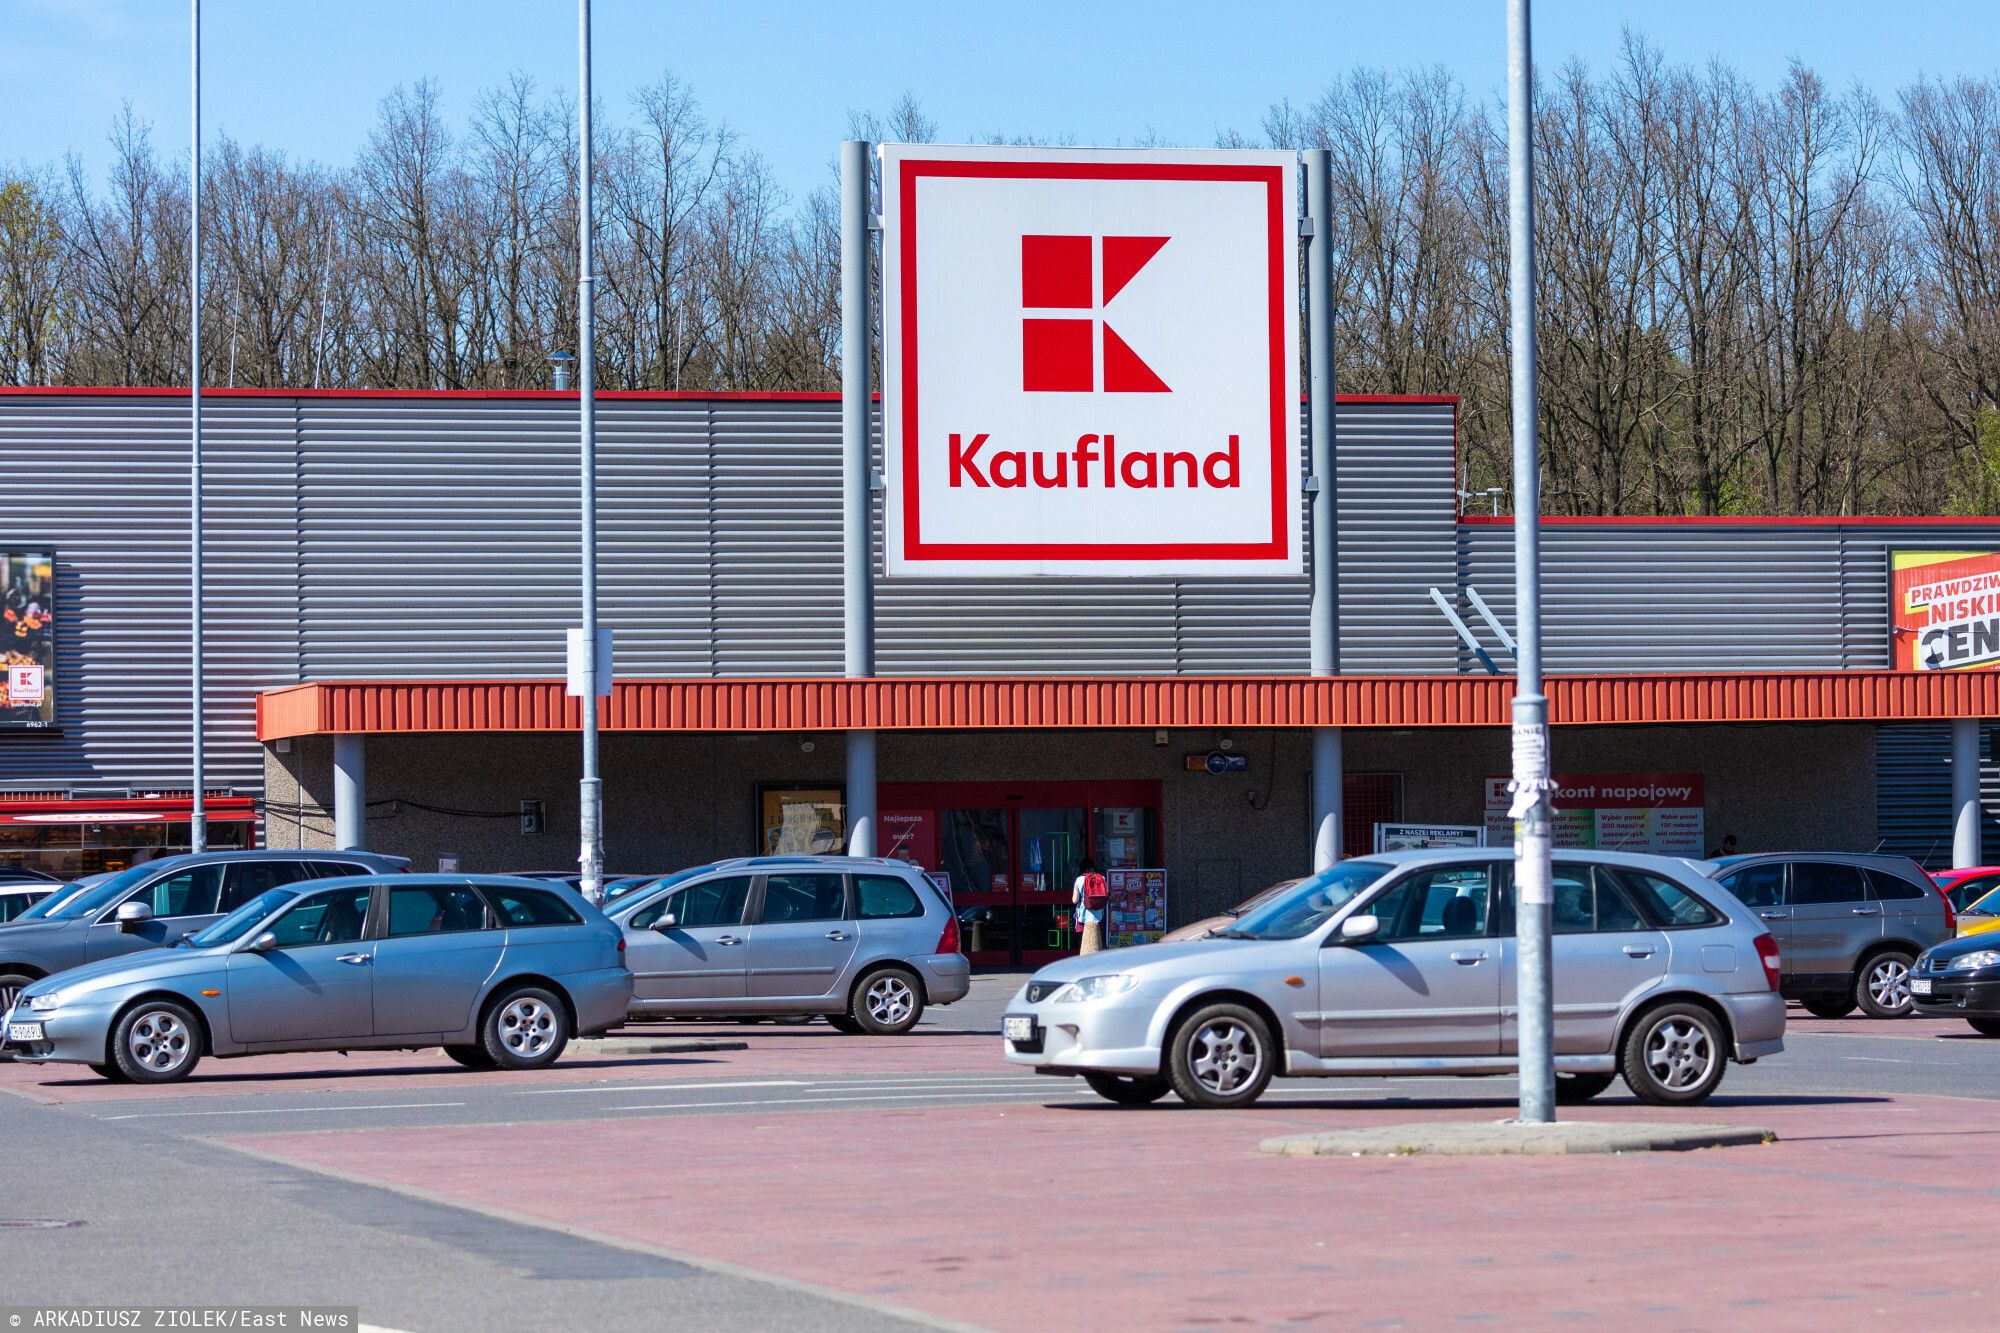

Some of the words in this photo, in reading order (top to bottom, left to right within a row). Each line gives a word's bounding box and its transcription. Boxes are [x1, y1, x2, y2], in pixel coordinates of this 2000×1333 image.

[948, 433, 1240, 489] Kaufland
[1931, 593, 2000, 625] NISKI
[1601, 784, 1692, 801] napojowy
[884, 815, 923, 823] Najlepsza
